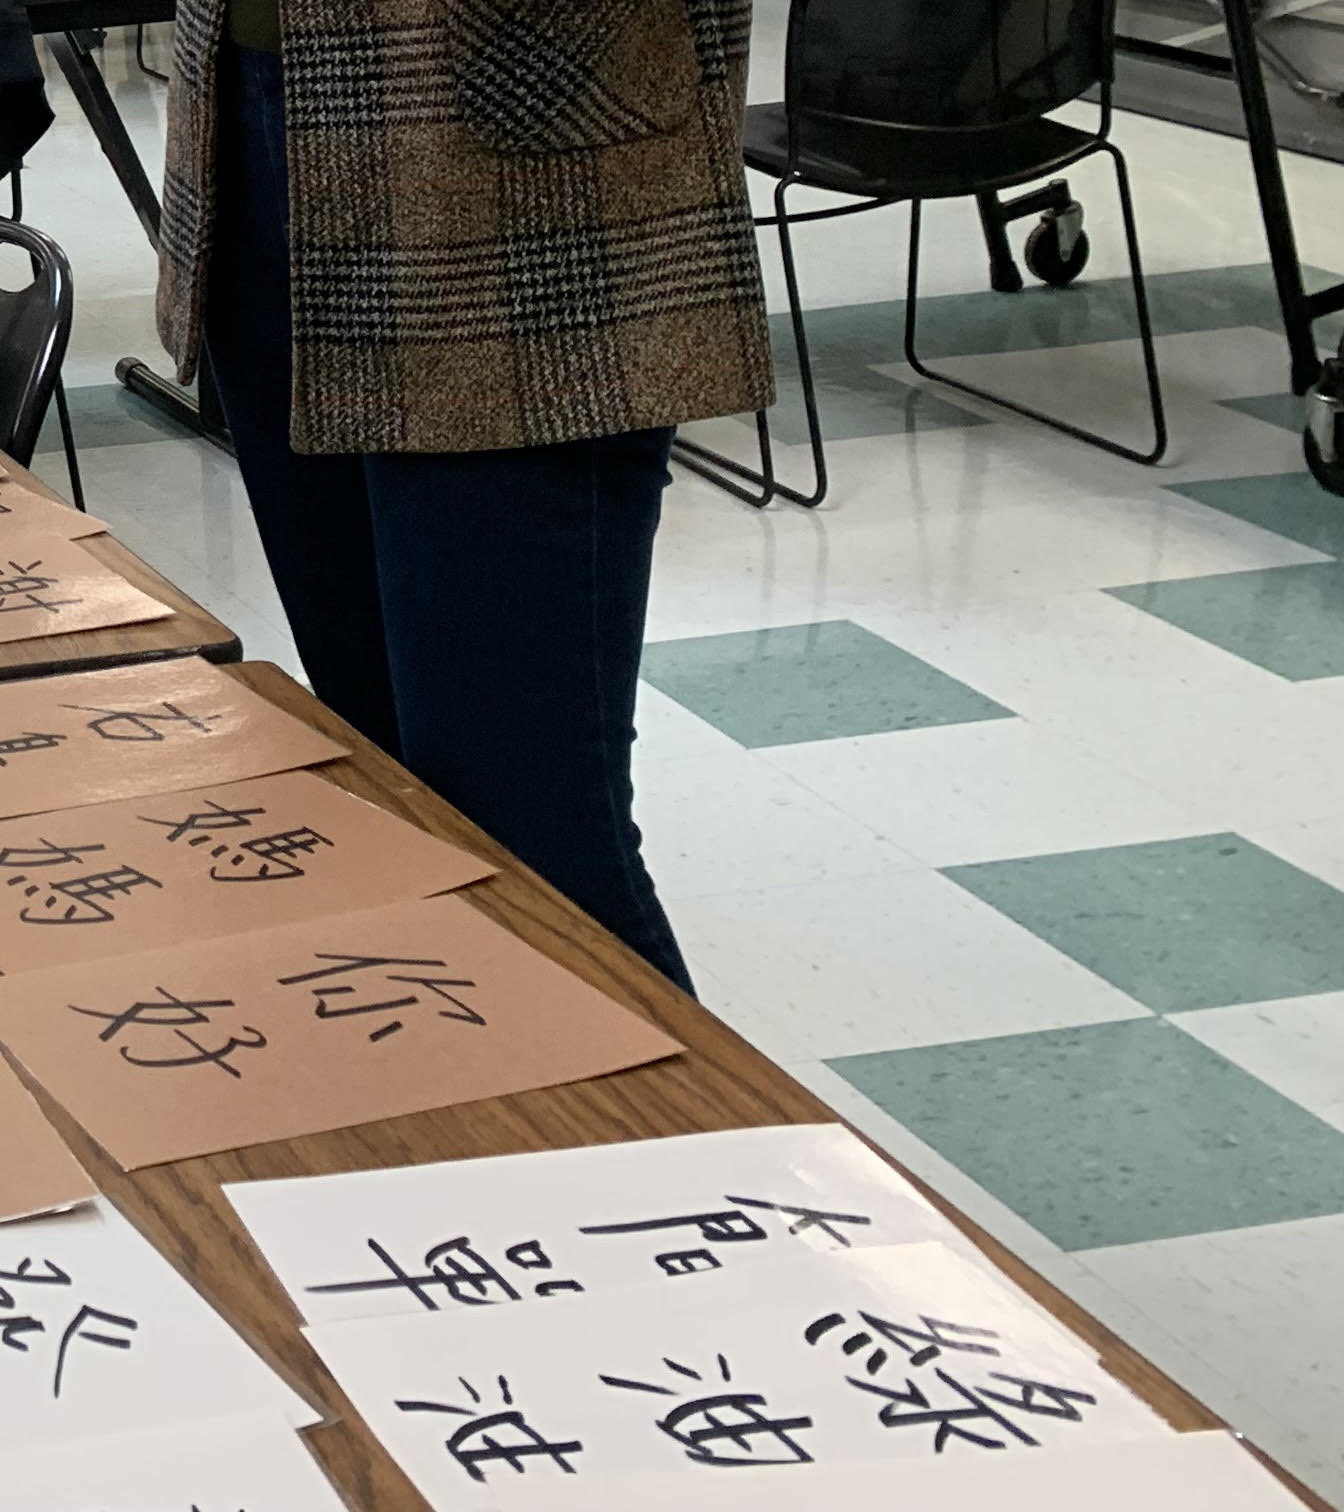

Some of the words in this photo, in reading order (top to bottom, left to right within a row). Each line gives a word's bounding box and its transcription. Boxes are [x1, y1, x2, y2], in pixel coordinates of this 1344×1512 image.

[68, 952, 488, 1079] 你好
[394, 1308, 1097, 1482] 綠油油
